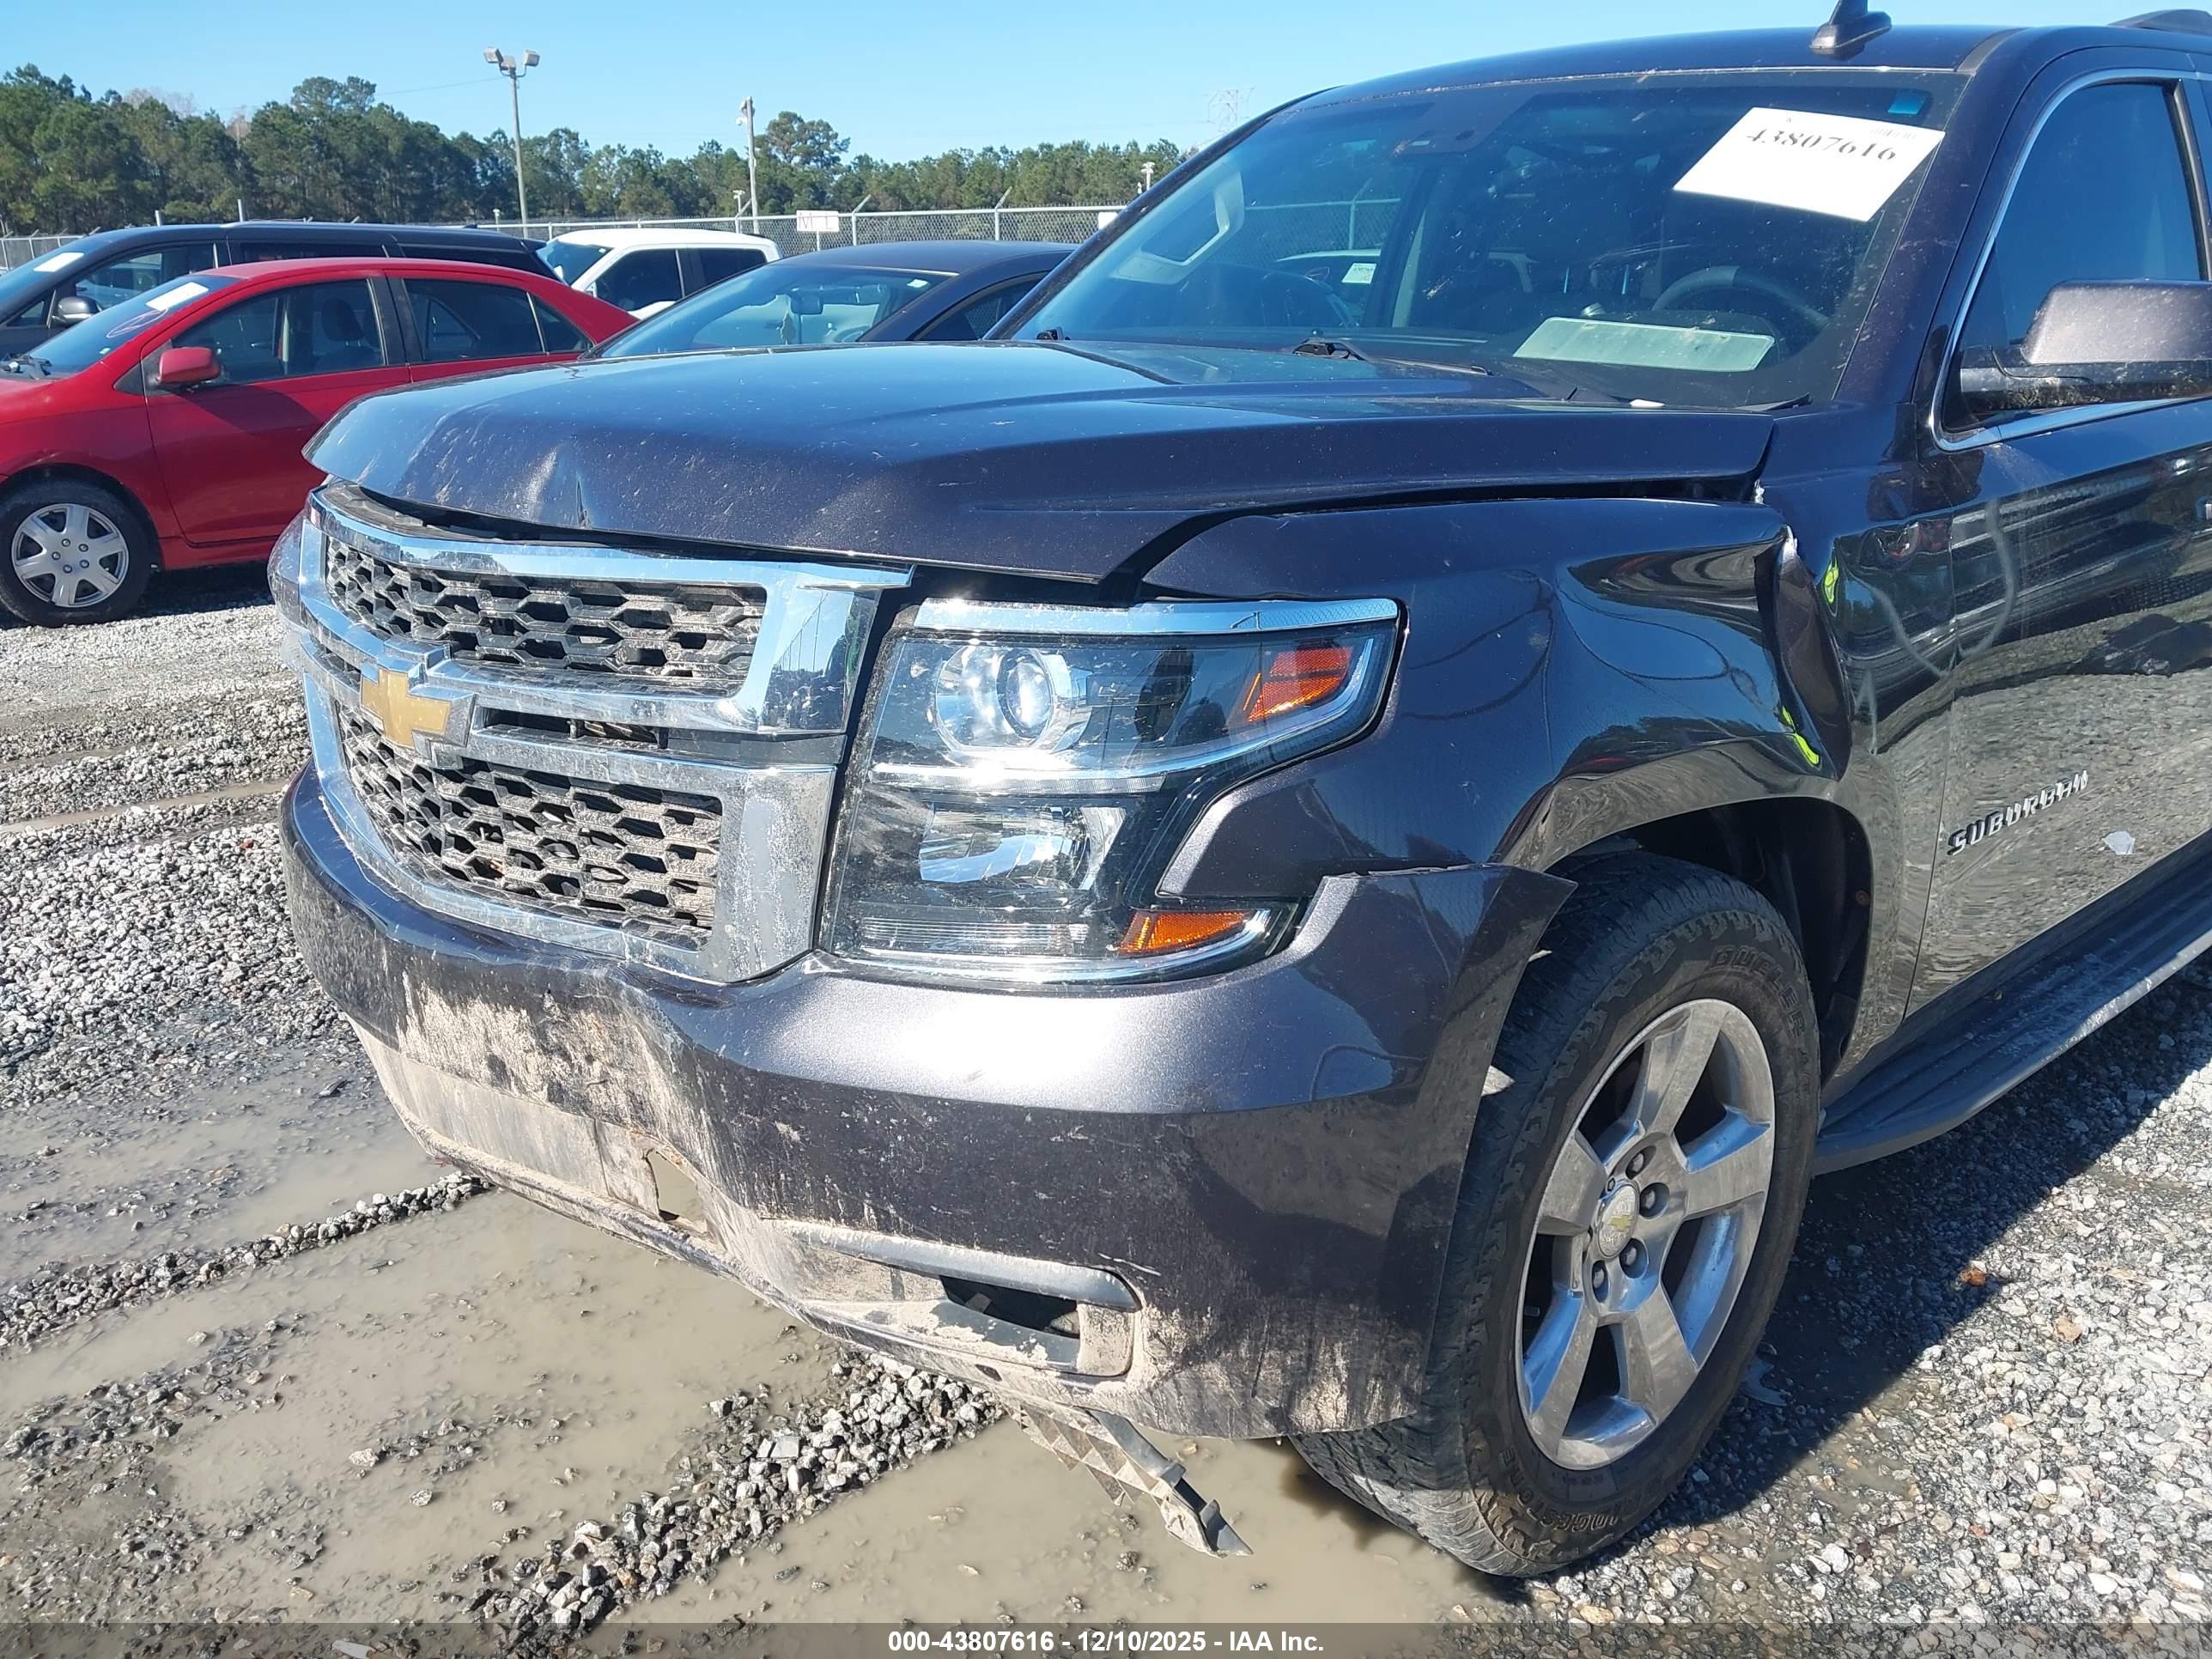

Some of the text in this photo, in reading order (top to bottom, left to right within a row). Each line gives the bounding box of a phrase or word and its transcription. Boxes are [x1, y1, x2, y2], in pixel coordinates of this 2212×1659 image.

[1746, 128, 1897, 162] 43807616
[1947, 769, 2089, 856] SUBURBAN
[1709, 945, 1806, 1038] DUELER
[1501, 1446, 1662, 1533] RIDGESTONE
